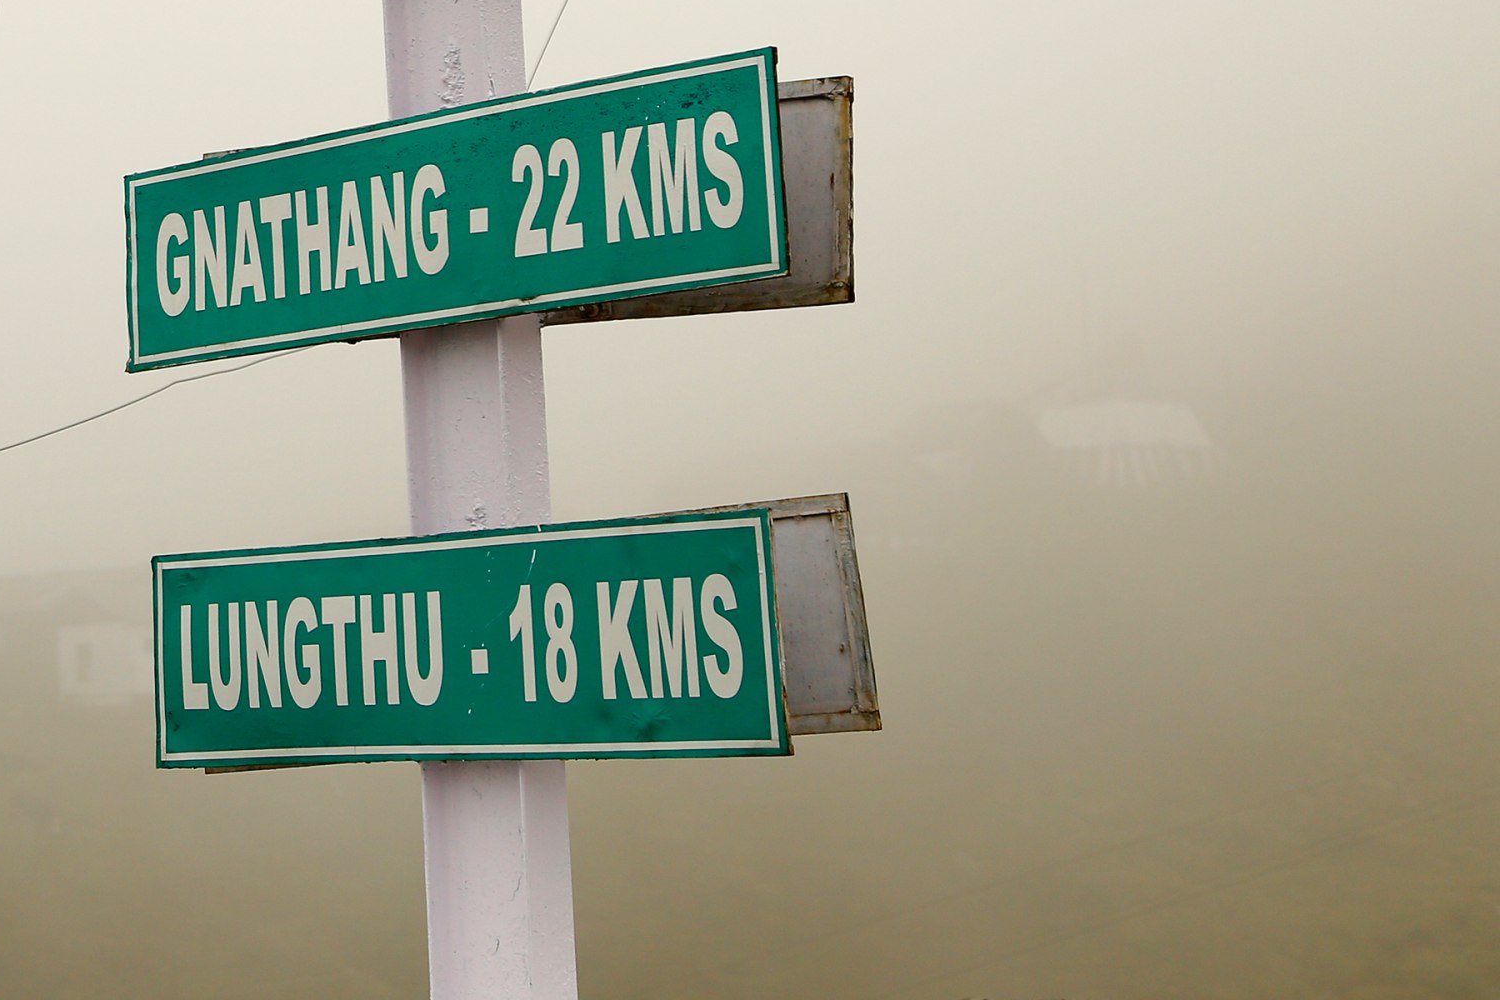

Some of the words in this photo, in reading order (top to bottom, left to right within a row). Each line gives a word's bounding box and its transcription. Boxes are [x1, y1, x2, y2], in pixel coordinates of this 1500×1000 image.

[155, 163, 451, 318] GNATHANG
[468, 206, 490, 235] -
[510, 136, 585, 259] 22
[600, 109, 745, 245] KMS
[179, 589, 445, 712] LUNGTHU
[469, 647, 490, 676] -
[508, 581, 579, 704] 18
[595, 572, 745, 701] KMS
